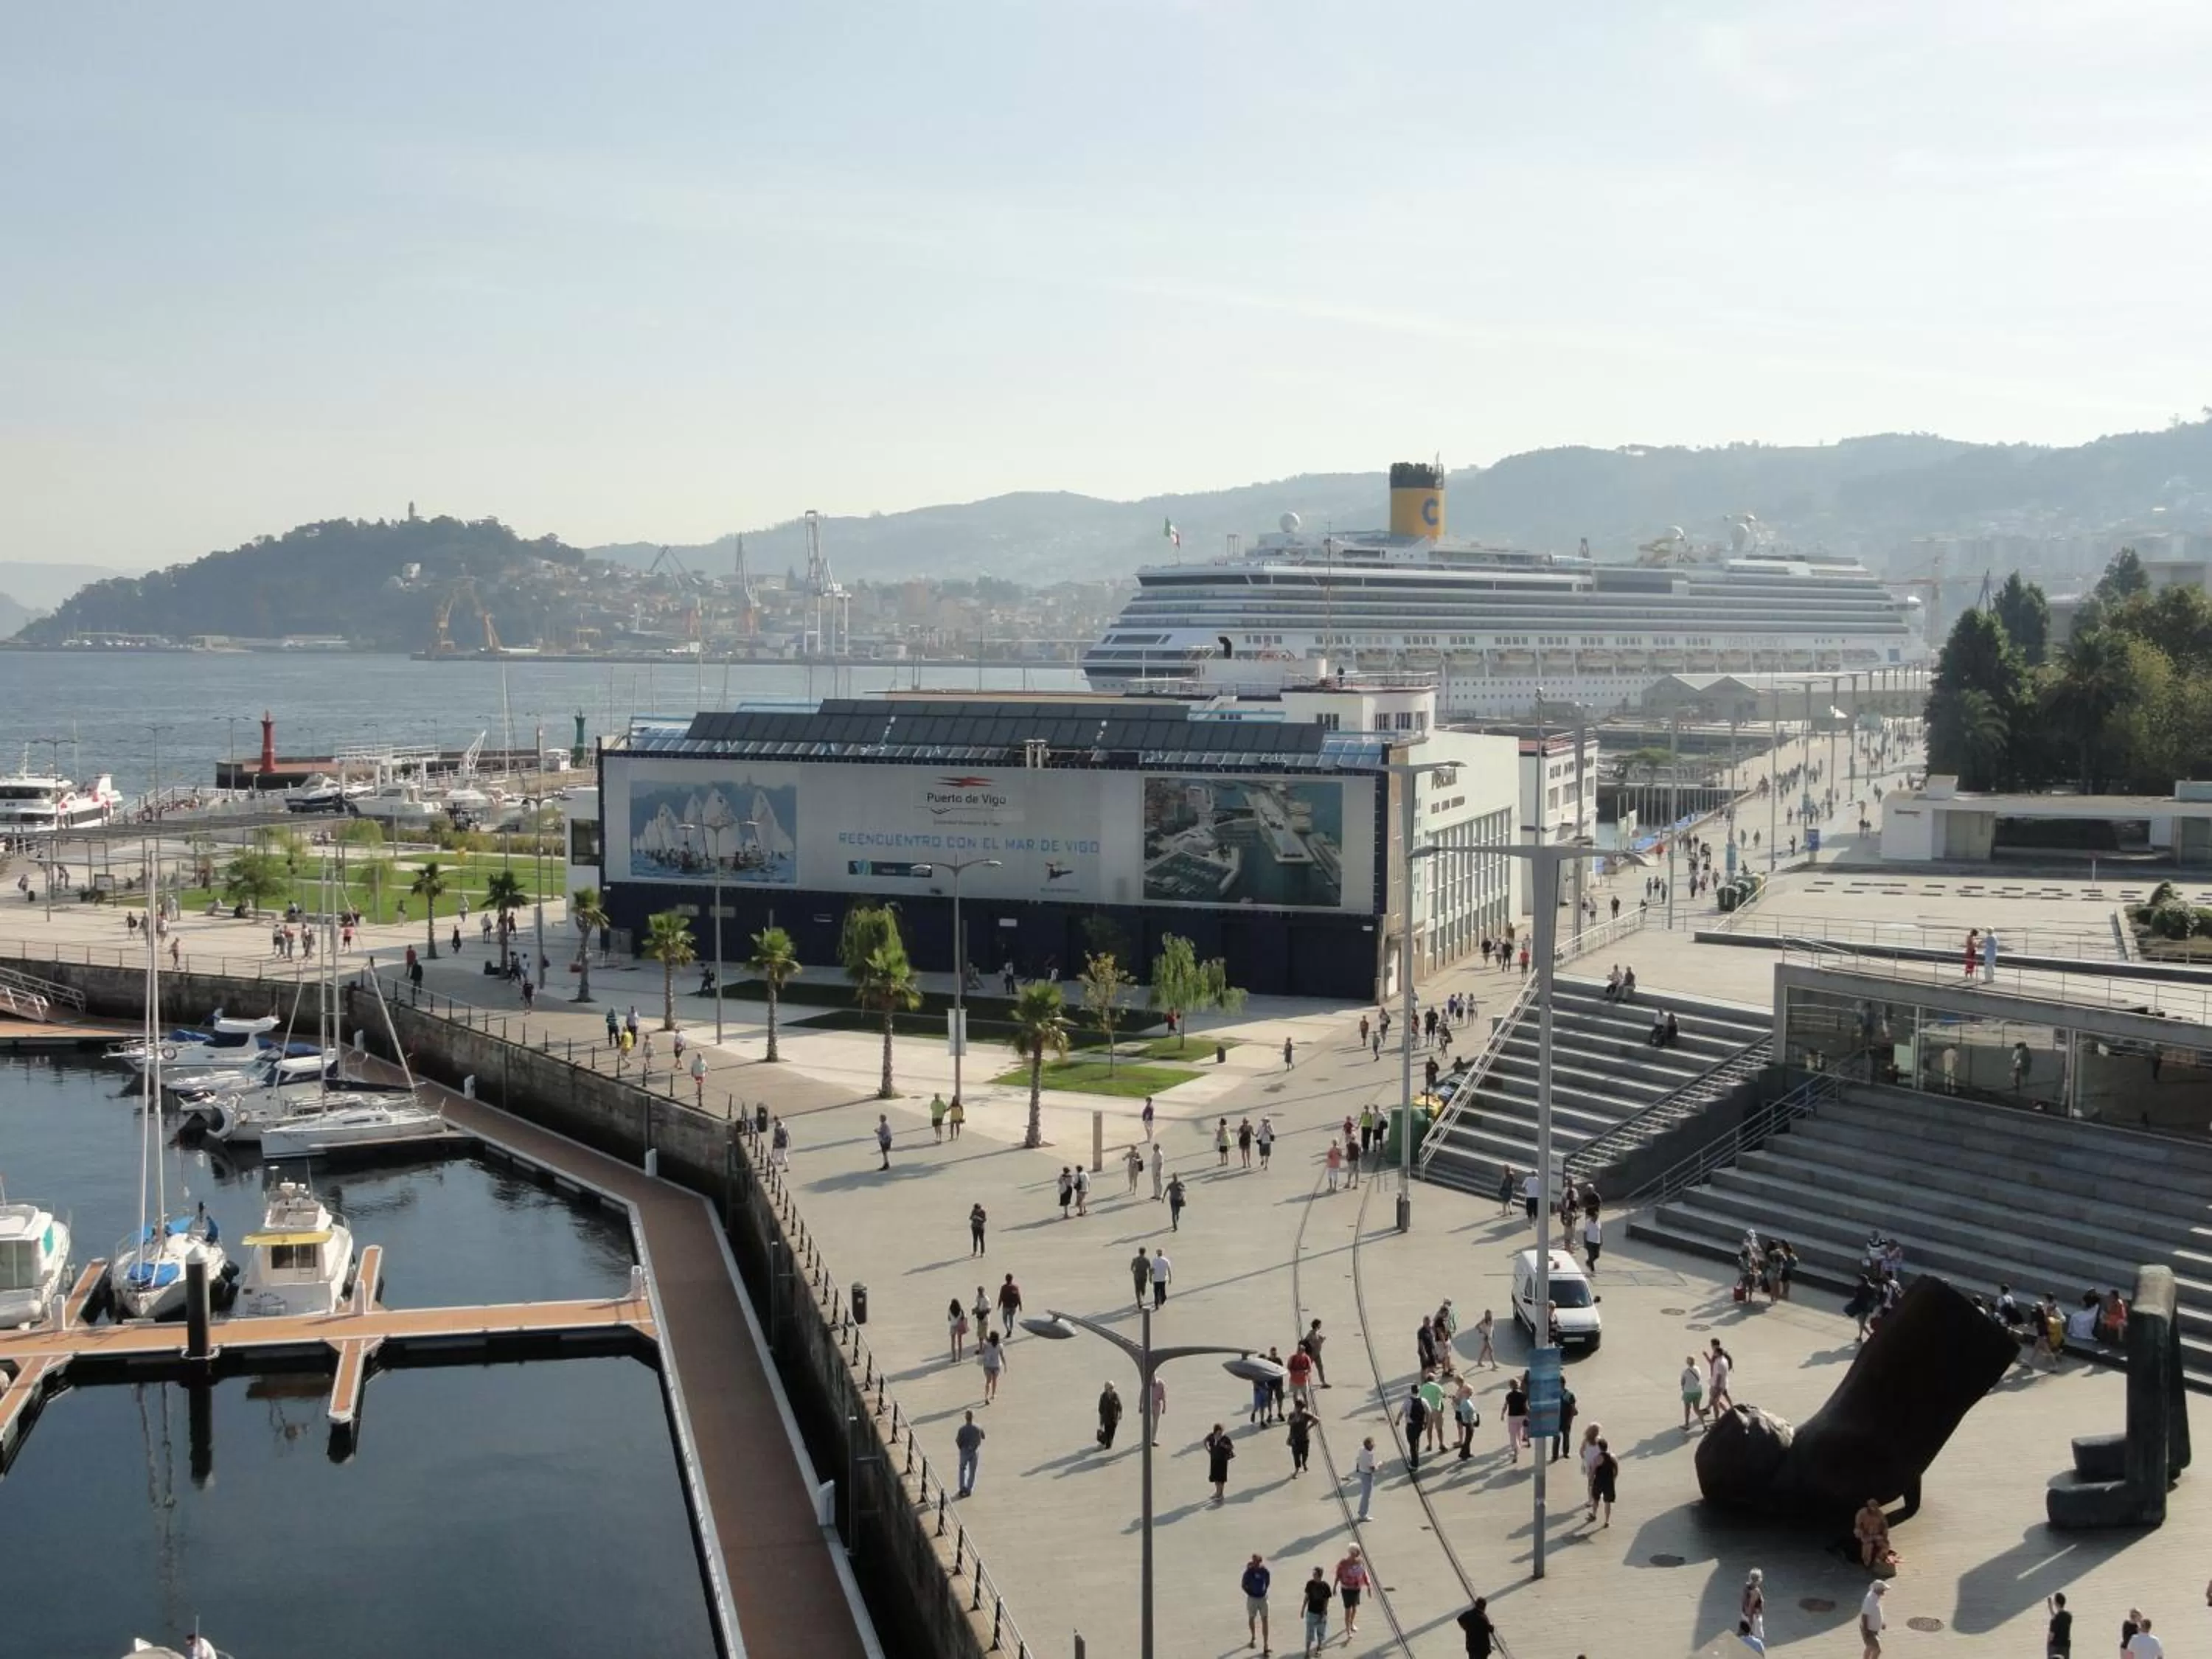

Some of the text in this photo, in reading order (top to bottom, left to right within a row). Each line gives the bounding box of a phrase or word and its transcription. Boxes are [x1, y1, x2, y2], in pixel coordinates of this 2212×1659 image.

[1421, 497, 1439, 526] C
[926, 793, 1006, 807] Puerto de Vigo
[839, 832, 1100, 854] REENCUENTRO CON EL MAR DE VIGO
